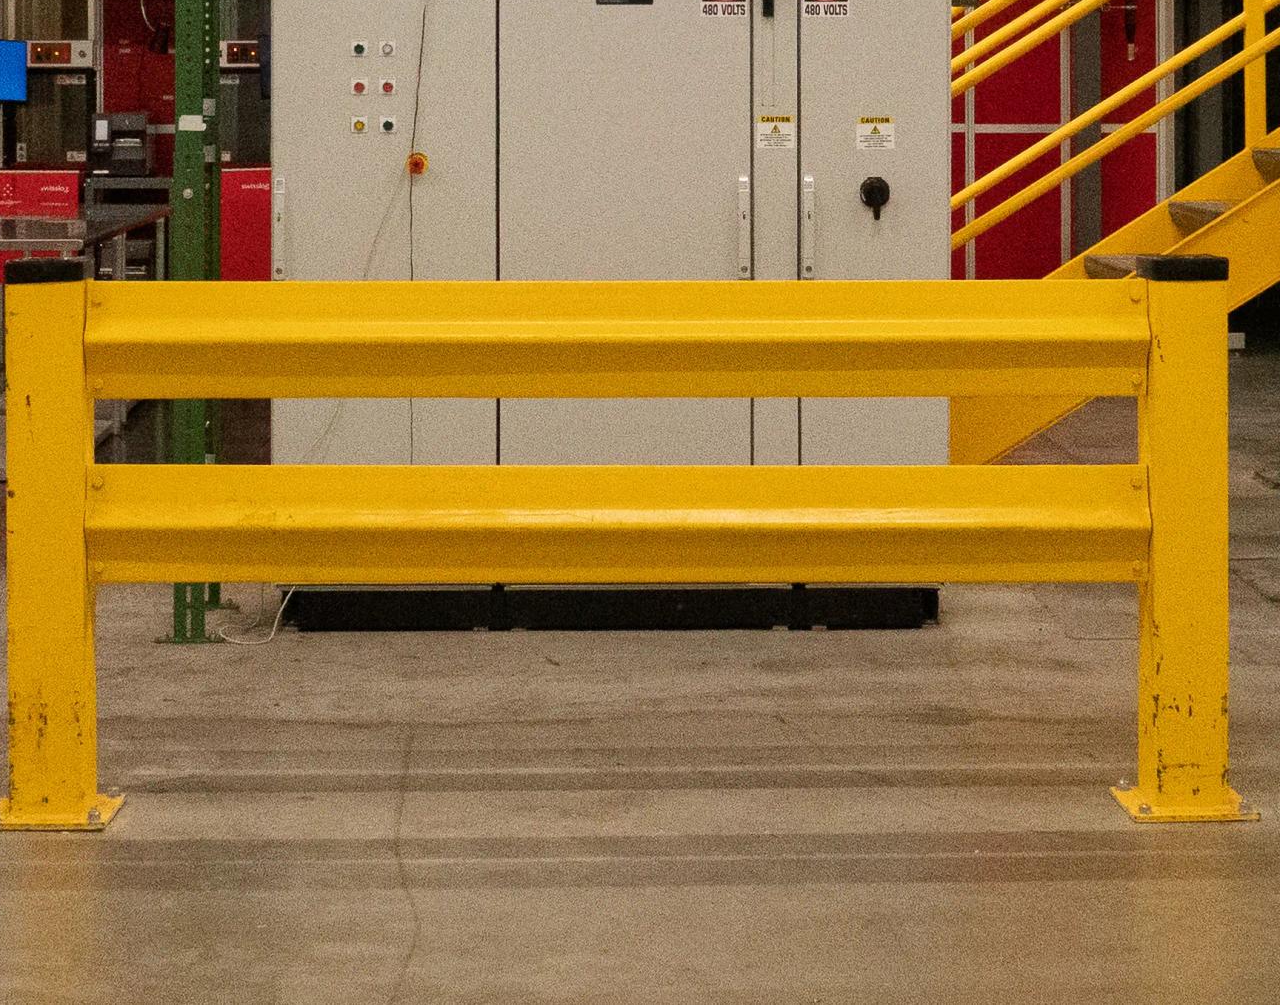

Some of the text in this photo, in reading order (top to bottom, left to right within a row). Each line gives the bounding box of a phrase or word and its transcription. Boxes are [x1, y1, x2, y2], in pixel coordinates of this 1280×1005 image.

[702, 3, 746, 16] 480 VOLTS
[804, 3, 848, 16] 480 VOLTS
